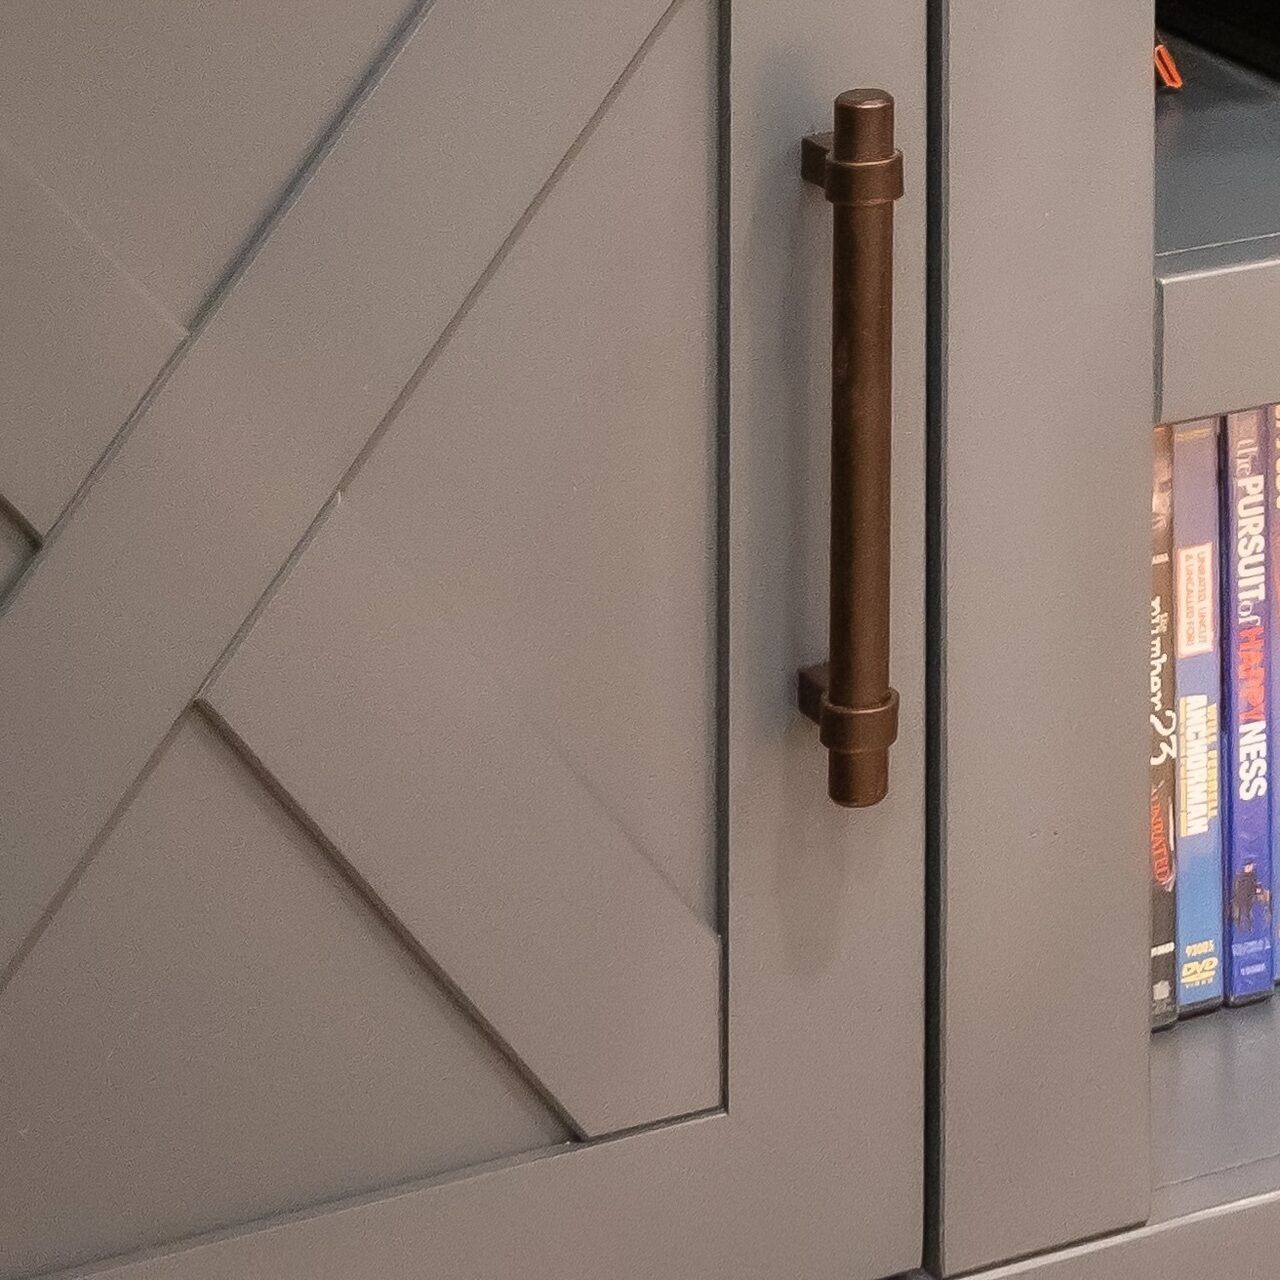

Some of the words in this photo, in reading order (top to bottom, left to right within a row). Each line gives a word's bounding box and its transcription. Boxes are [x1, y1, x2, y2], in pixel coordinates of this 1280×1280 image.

[1237, 475, 1266, 602] PURSUIT
[1238, 598, 1262, 626] of
[1150, 710, 1177, 766] 23
